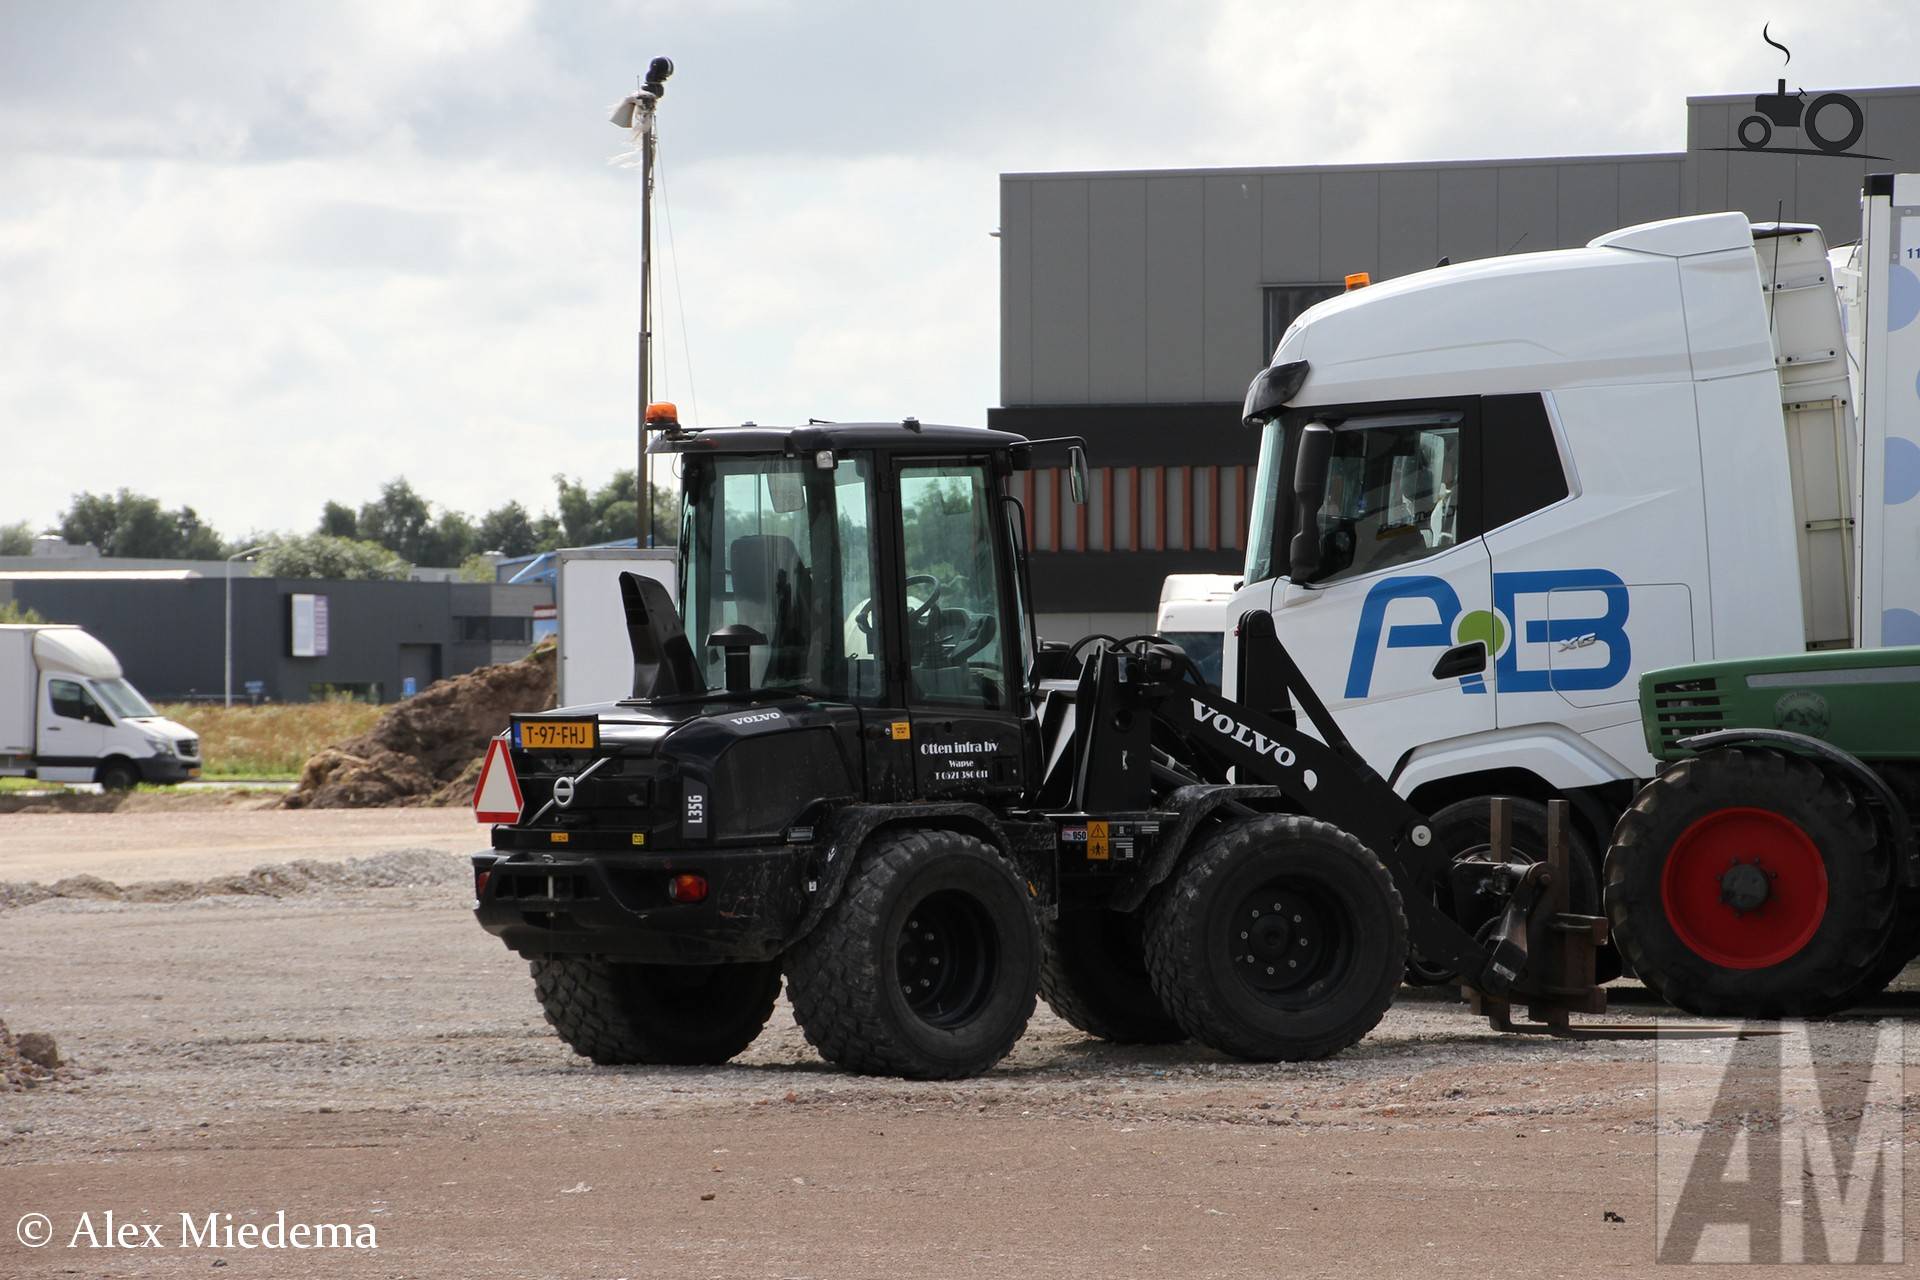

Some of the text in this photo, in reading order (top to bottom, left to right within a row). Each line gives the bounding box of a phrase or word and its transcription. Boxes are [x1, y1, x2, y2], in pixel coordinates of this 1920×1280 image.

[730, 712, 781, 725] VOLVO
[526, 726, 586, 745] T-97-FHJ
[1190, 697, 1296, 767] VOLVO
[920, 743, 953, 755] Otten
[954, 741, 982, 753] infra
[687, 794, 703, 824] L35G
